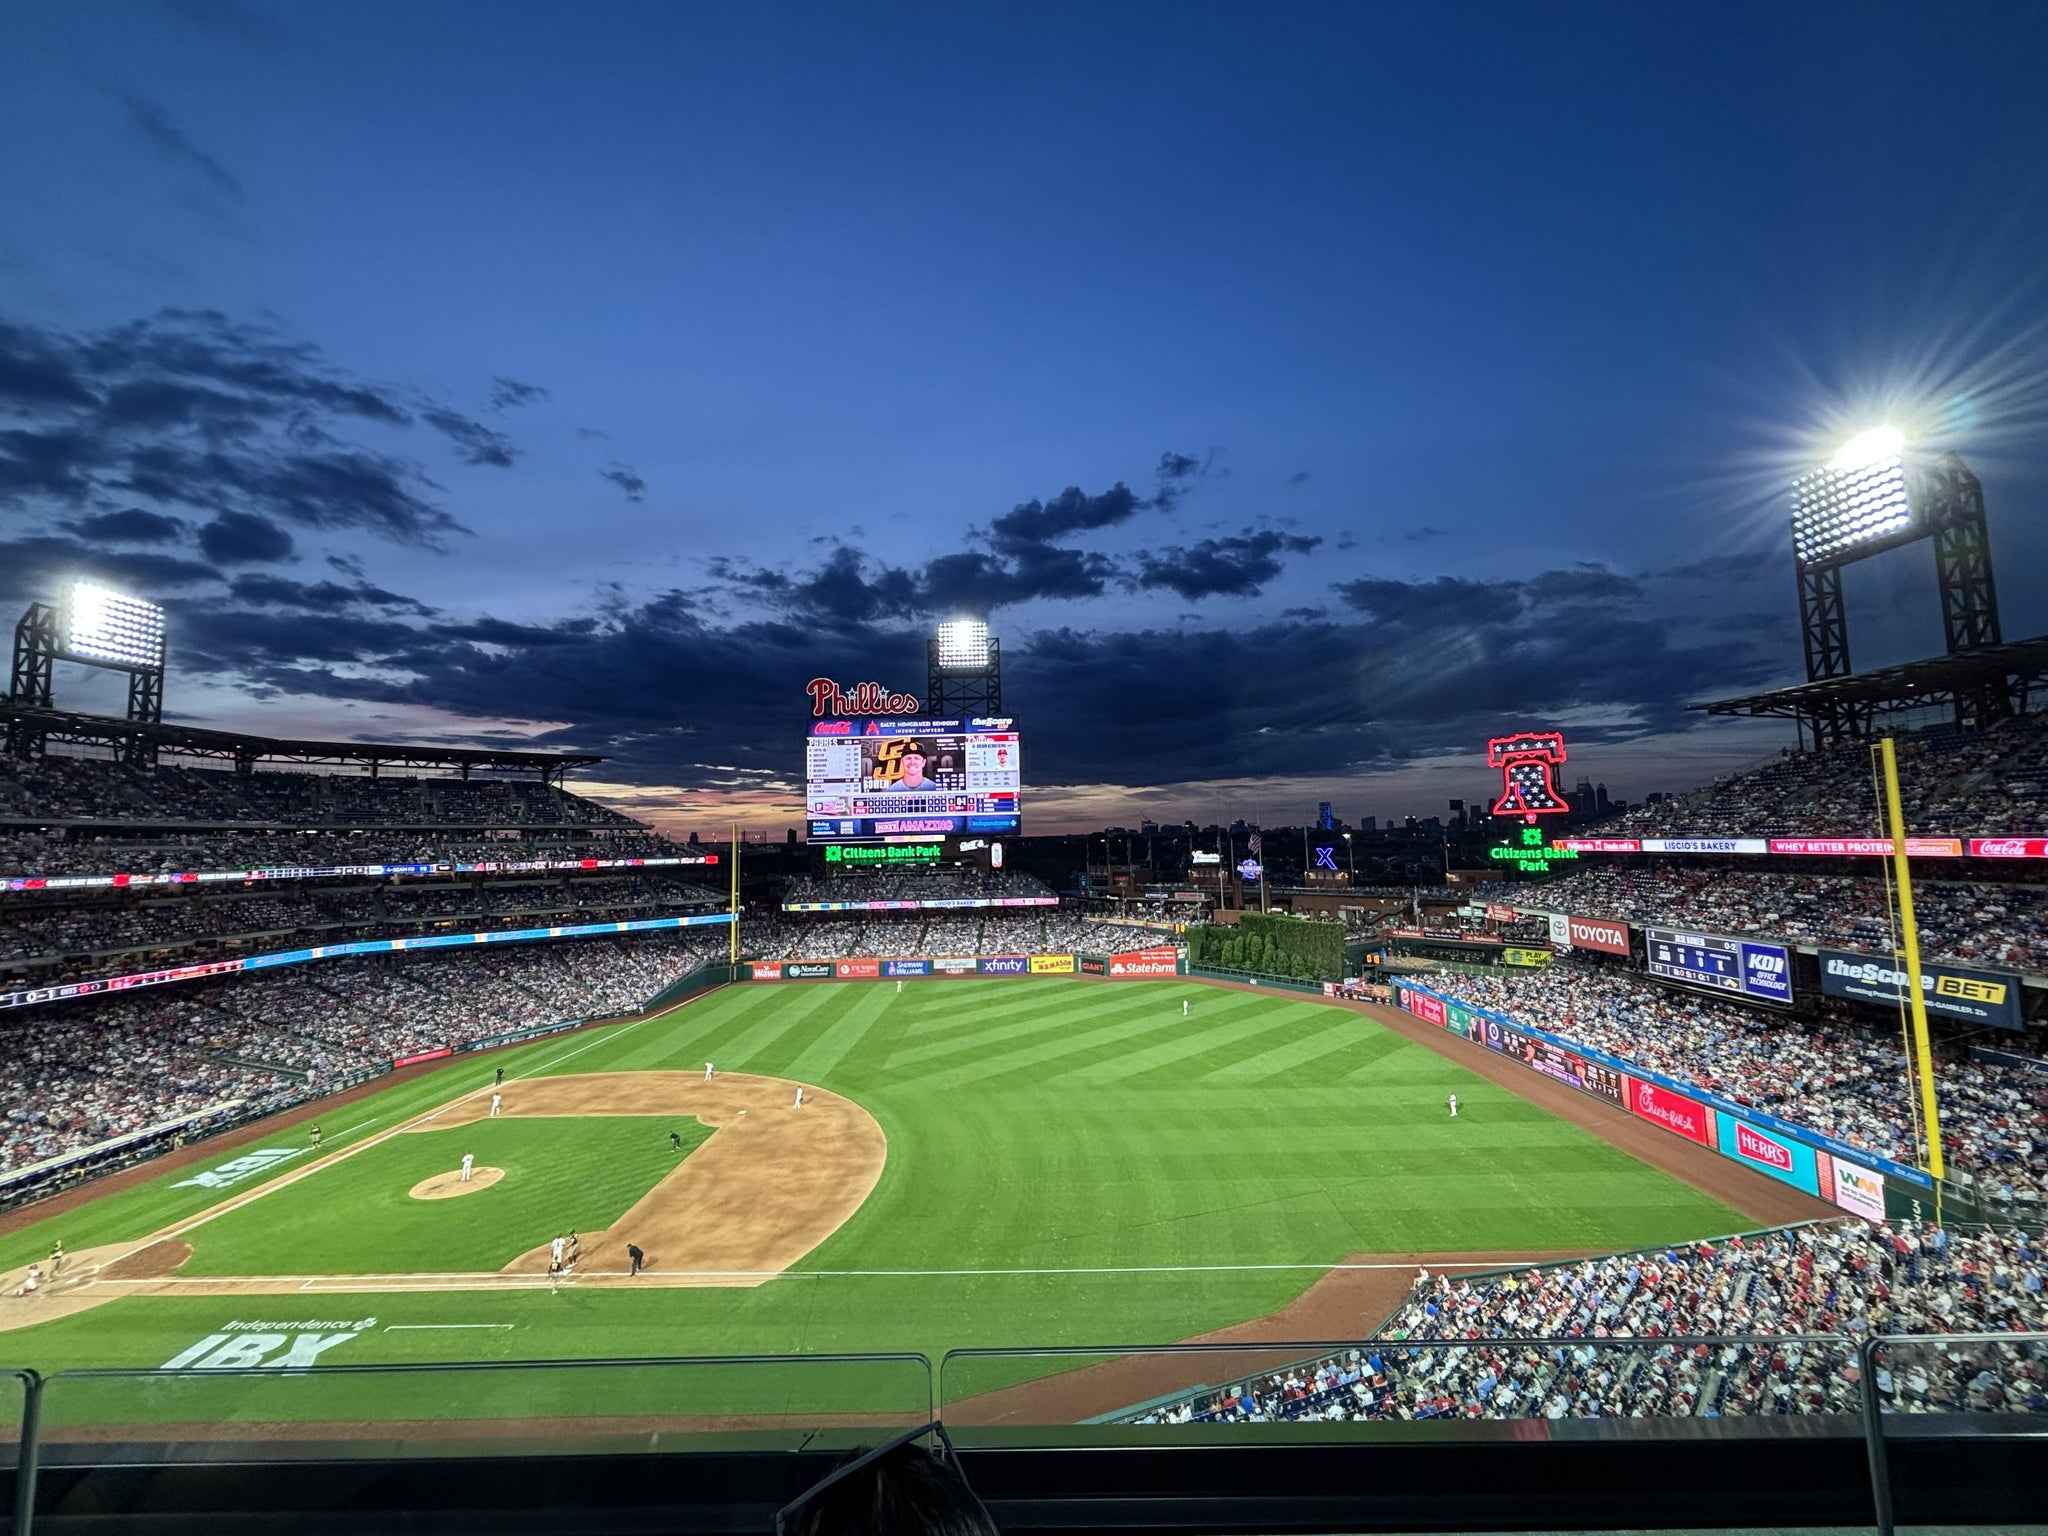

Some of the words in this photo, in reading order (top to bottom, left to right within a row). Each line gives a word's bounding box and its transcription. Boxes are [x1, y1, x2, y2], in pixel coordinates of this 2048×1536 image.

[807, 678, 919, 716] Phillies
[971, 717, 1013, 726] theScore
[863, 779, 889, 789] BOWEN
[900, 819, 954, 832] AMAZING
[972, 820, 1010, 828] Independence
[843, 846, 887, 859] Citizens
[888, 845, 915, 858] Bank
[916, 844, 941, 857] Park
[1664, 840, 1698, 850] LISCIO'S
[1700, 841, 1736, 850] BAKERY
[1777, 842, 1805, 852] WHEY
[1807, 842, 1844, 852] BETTER
[1980, 840, 2026, 855] Coca-Cola
[1316, 847, 1338, 871] X
[1491, 847, 1542, 859] Citizens
[1544, 847, 1579, 859] Bank
[1519, 859, 1549, 871] Park
[1571, 923, 1625, 947] TOYOTA
[1724, 942, 1737, 951] 0-2
[1525, 951, 1542, 959] PLAY
[800, 964, 829, 973] NovaCare
[896, 961, 923, 969] SHERWIN
[985, 959, 1023, 972] xfinity
[1082, 962, 1104, 971] GIANT
[1126, 962, 1151, 973] State
[1151, 962, 1176, 973] Farm
[1748, 953, 1785, 974] KDI
[754, 969, 780, 978] Wawa
[1756, 971, 1778, 981] OFFICE
[1827, 959, 1935, 990] theScoe
[1942, 978, 1999, 999] BET
[1749, 976, 1787, 991] TECHNOLOGY
[1424, 997, 1442, 1012] Temple
[1424, 1008, 1441, 1020] Health
[1639, 1084, 1696, 1133] Chick-fil-A
[1741, 1132, 1786, 1164] HERR'S
[1825, 1140, 1870, 1161] Independence
[1838, 1169, 1882, 1197] WM
[221, 1319, 353, 1333] Independence
[159, 1333, 359, 1377] IBX
